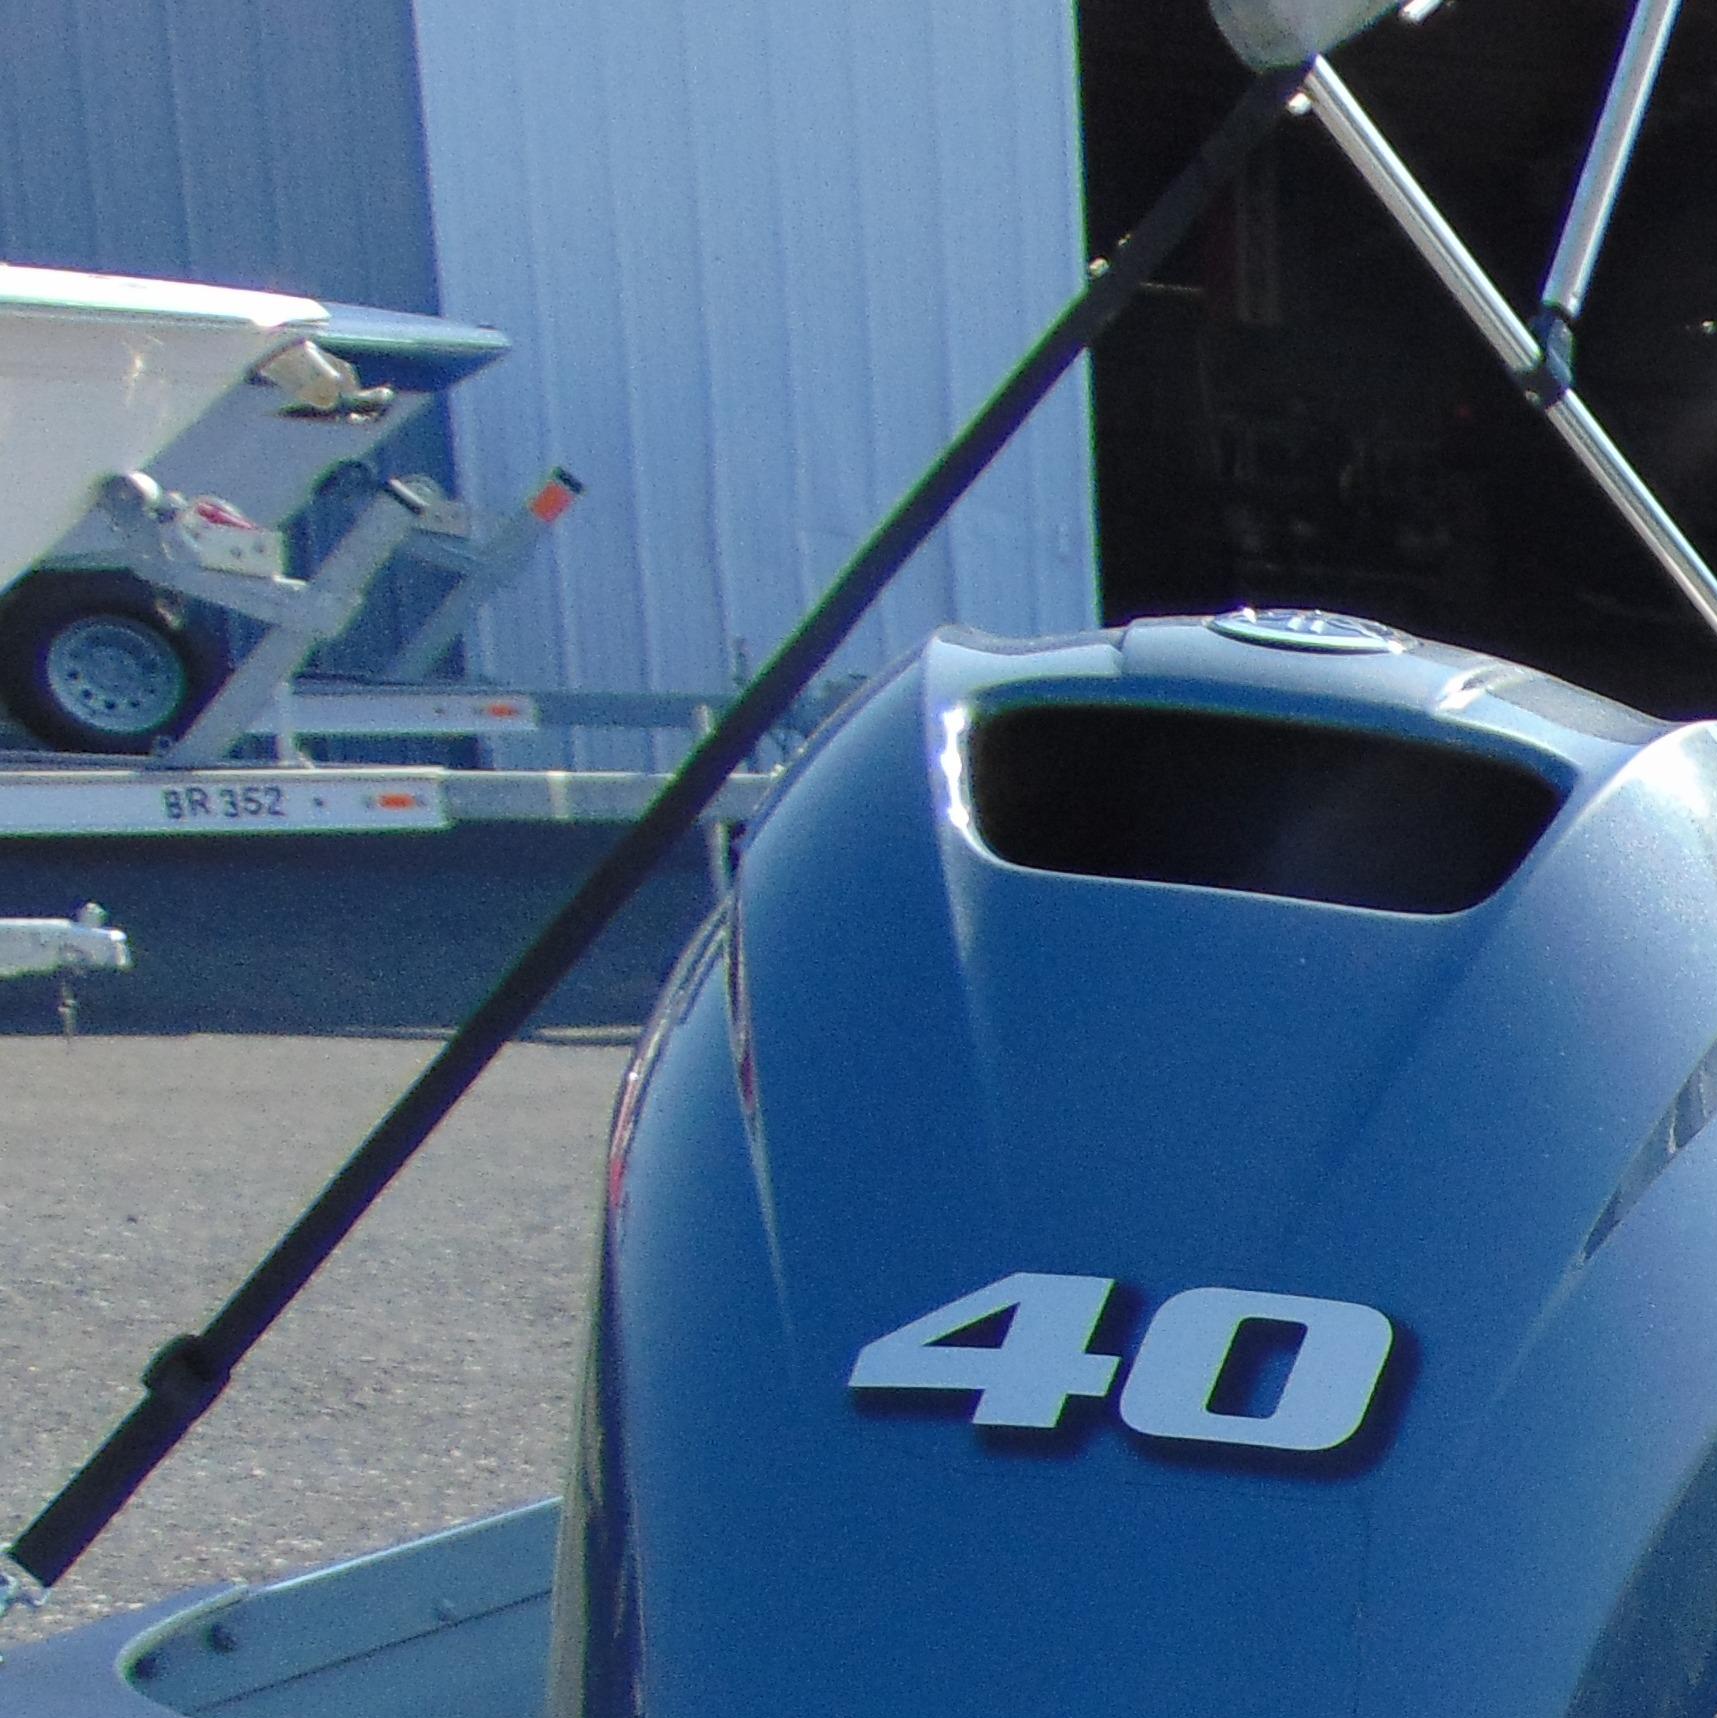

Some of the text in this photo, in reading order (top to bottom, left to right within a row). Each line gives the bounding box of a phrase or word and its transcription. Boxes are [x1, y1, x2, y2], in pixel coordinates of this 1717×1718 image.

[163, 786, 286, 819] BR 352
[848, 1271, 1396, 1451] 40
